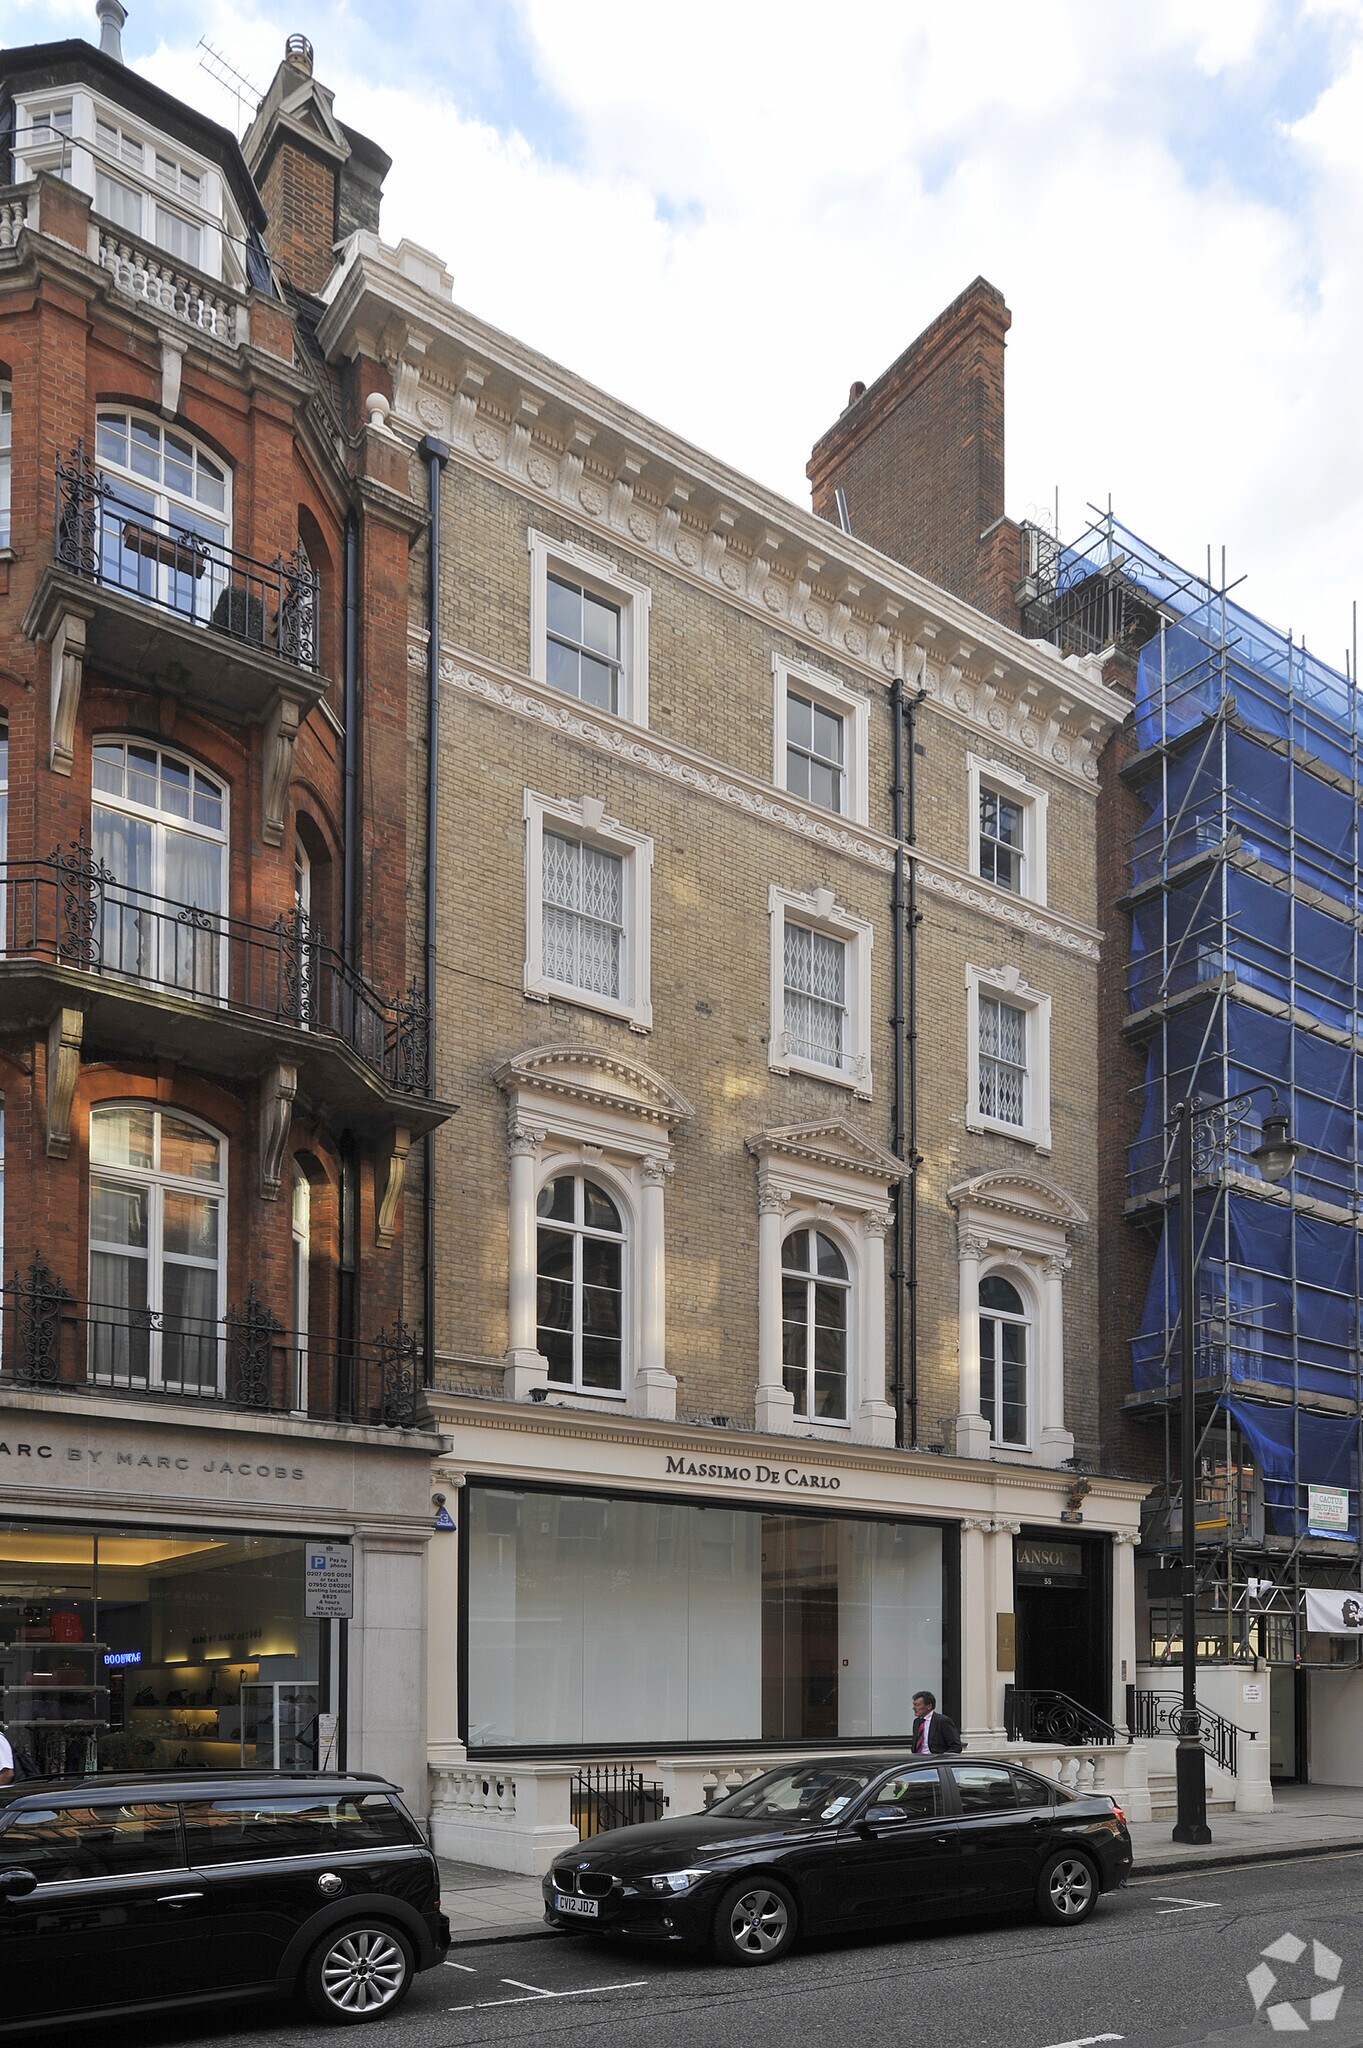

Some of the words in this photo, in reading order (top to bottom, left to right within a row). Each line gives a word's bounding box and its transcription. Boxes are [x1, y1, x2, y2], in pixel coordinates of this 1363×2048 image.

[68, 1448, 103, 1463] BY
[117, 1452, 189, 1471] MARC
[203, 1461, 304, 1480] JACOBS
[665, 1456, 751, 1481] MASSIMO
[784, 1469, 841, 1489] CARLO
[1319, 1496, 1343, 1505] CACTUS
[1313, 1503, 1344, 1513] SECURITY
[314, 1557, 324, 1568] P
[560, 1897, 576, 1910] CV12
[577, 1900, 594, 1913] JDZ
